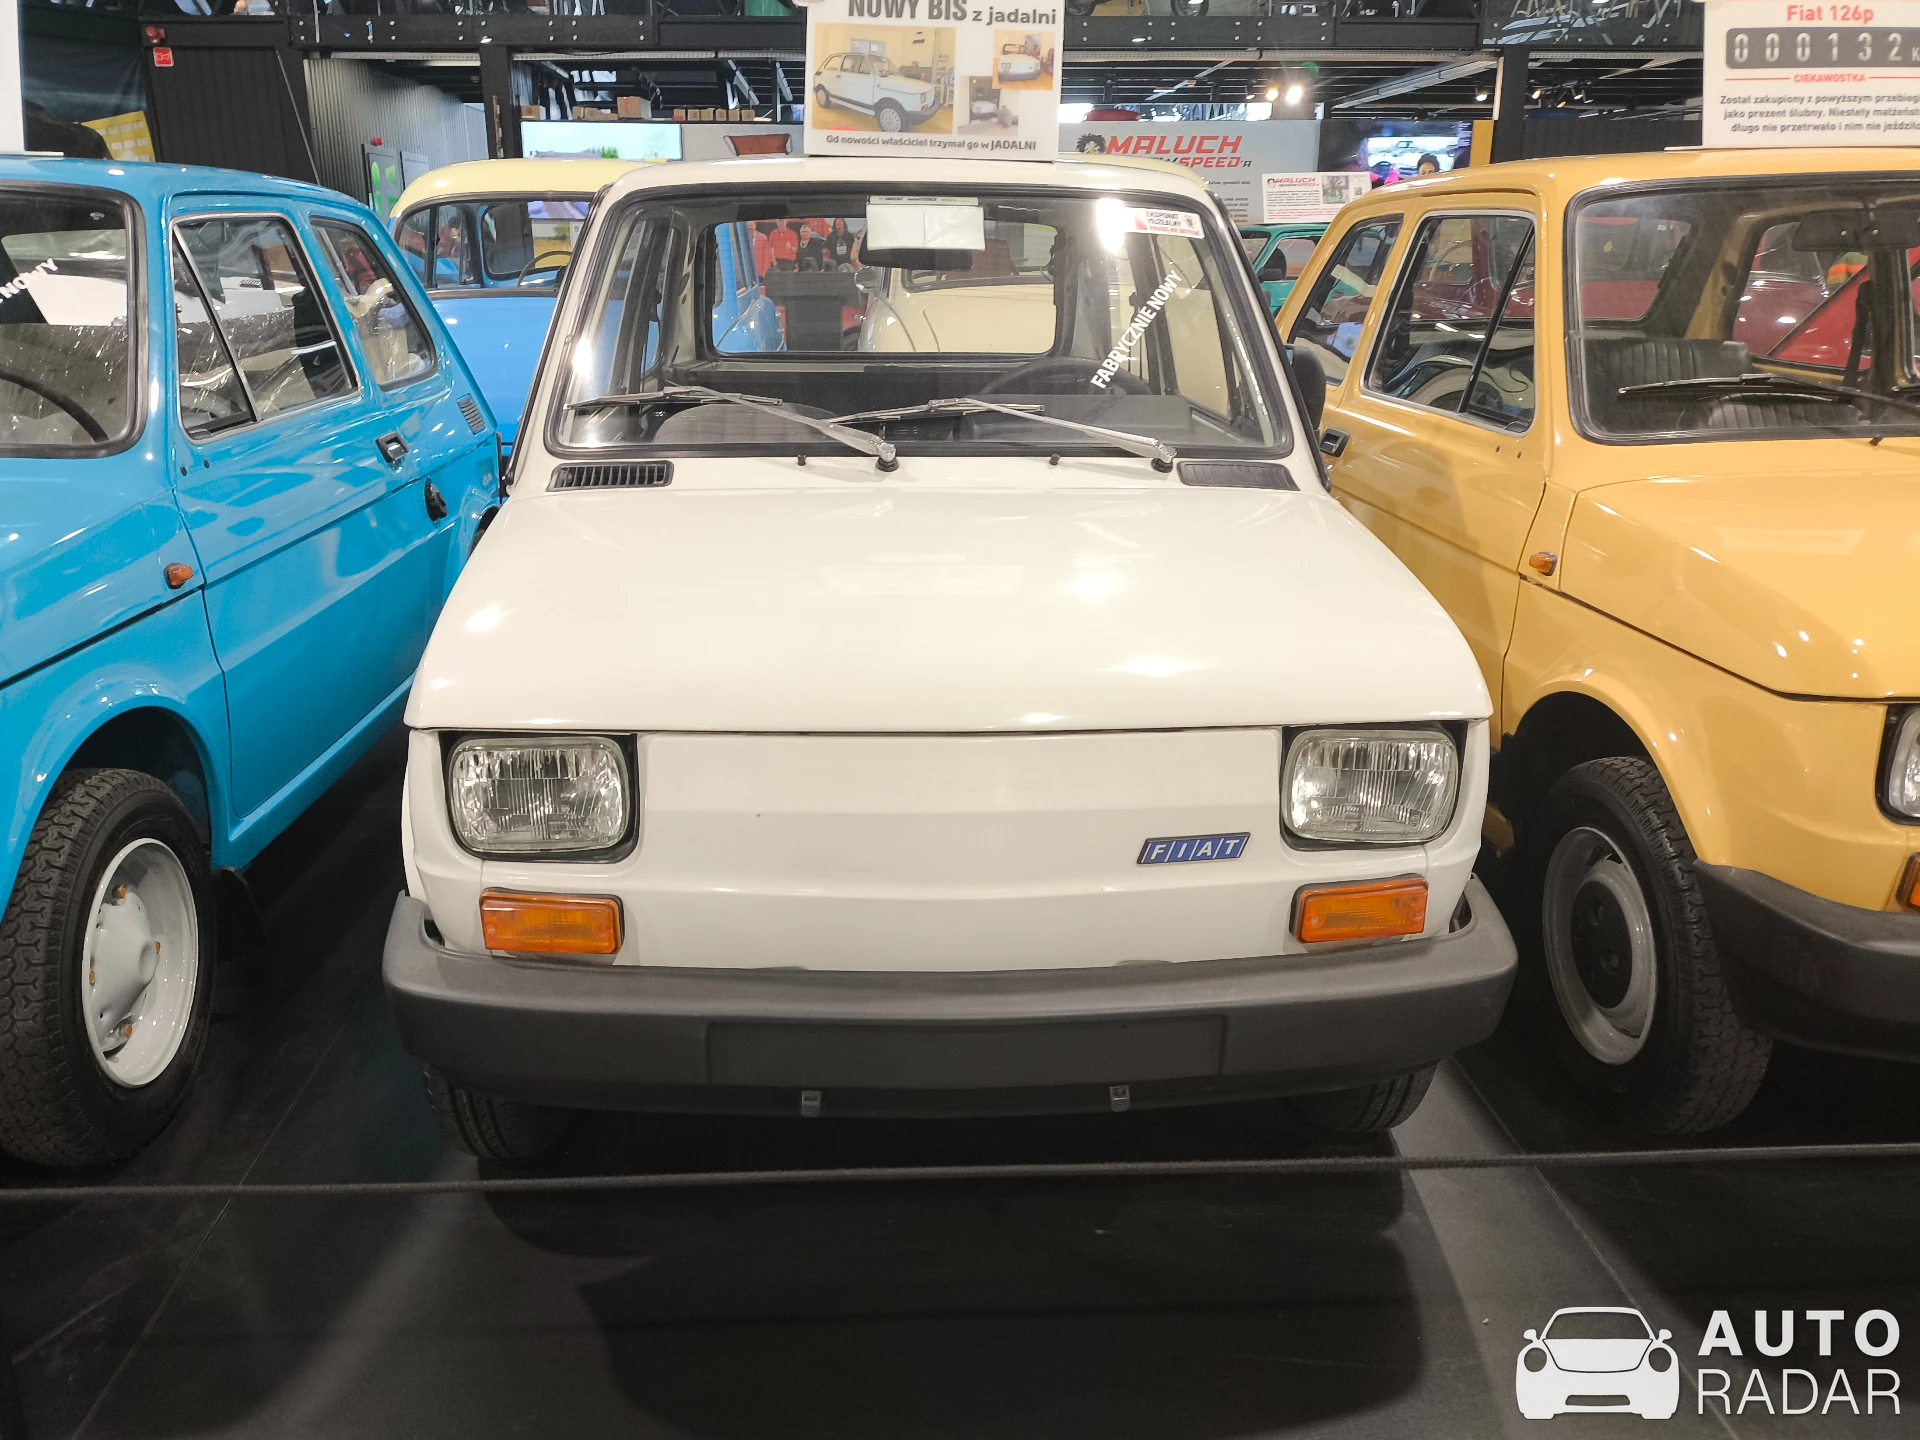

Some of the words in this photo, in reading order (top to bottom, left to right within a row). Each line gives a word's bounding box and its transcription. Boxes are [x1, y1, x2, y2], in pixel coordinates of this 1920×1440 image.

[848, 0, 919, 18] NOWY
[928, 0, 967, 21] BIS
[972, 10, 982, 21] z
[986, 6, 1056, 26] jadalni
[1787, 5, 1823, 21] Fiat
[1830, 5, 1875, 24] 126p
[1794, 73, 1866, 83] CIEKAWOSTKA
[1720, 95, 1751, 104] Został
[1753, 95, 1805, 105] zakupiony
[1815, 94, 1872, 104] powyższym
[1723, 109, 1745, 120] jako
[1748, 109, 1786, 119] prezent
[1789, 107, 1826, 118] ślubny,
[1828, 107, 1870, 118] Niestety
[1731, 123, 1760, 134] długo
[1762, 123, 1777, 131] nie
[1780, 122, 1836, 133] przetrwało
[1844, 122, 1864, 130] nim
[1866, 122, 1881, 130] nie
[826, 135, 839, 143] Od
[841, 136, 879, 145] nowości
[881, 137, 927, 146] właściciel
[929, 139, 965, 149] trzymał
[967, 141, 979, 150] go
[990, 140, 1036, 150] JADALNI
[1106, 135, 1243, 155] MALUCH
[1090, 305, 1157, 389] FABRYCZNIE
[1146, 269, 1182, 311] NOWY
[1150, 840, 1240, 860] FIAT
